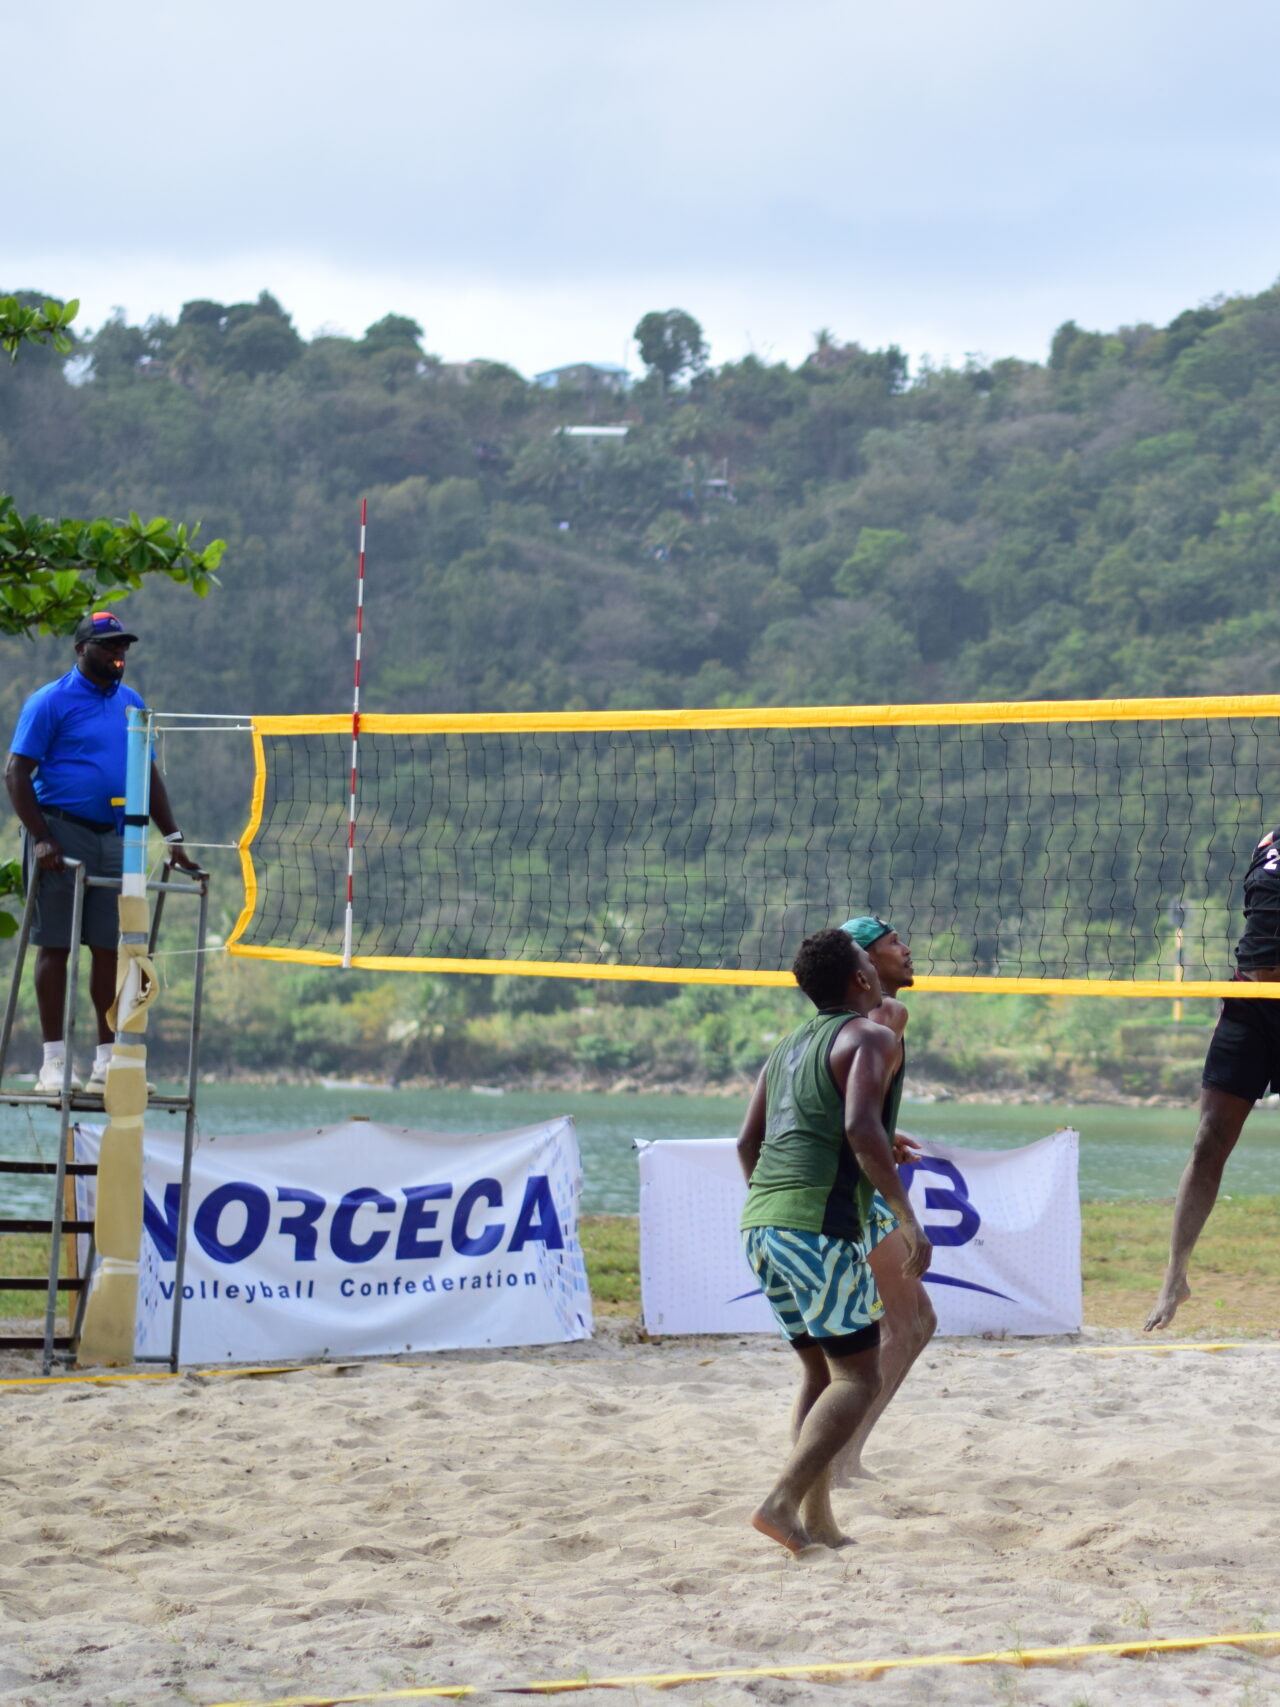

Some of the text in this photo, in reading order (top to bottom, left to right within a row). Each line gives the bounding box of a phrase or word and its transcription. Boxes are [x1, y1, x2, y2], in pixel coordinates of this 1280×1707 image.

[1263, 848, 1280, 870] 2
[143, 1175, 565, 1264] NORCECA
[159, 1270, 537, 1304] Volleyball Confederation
